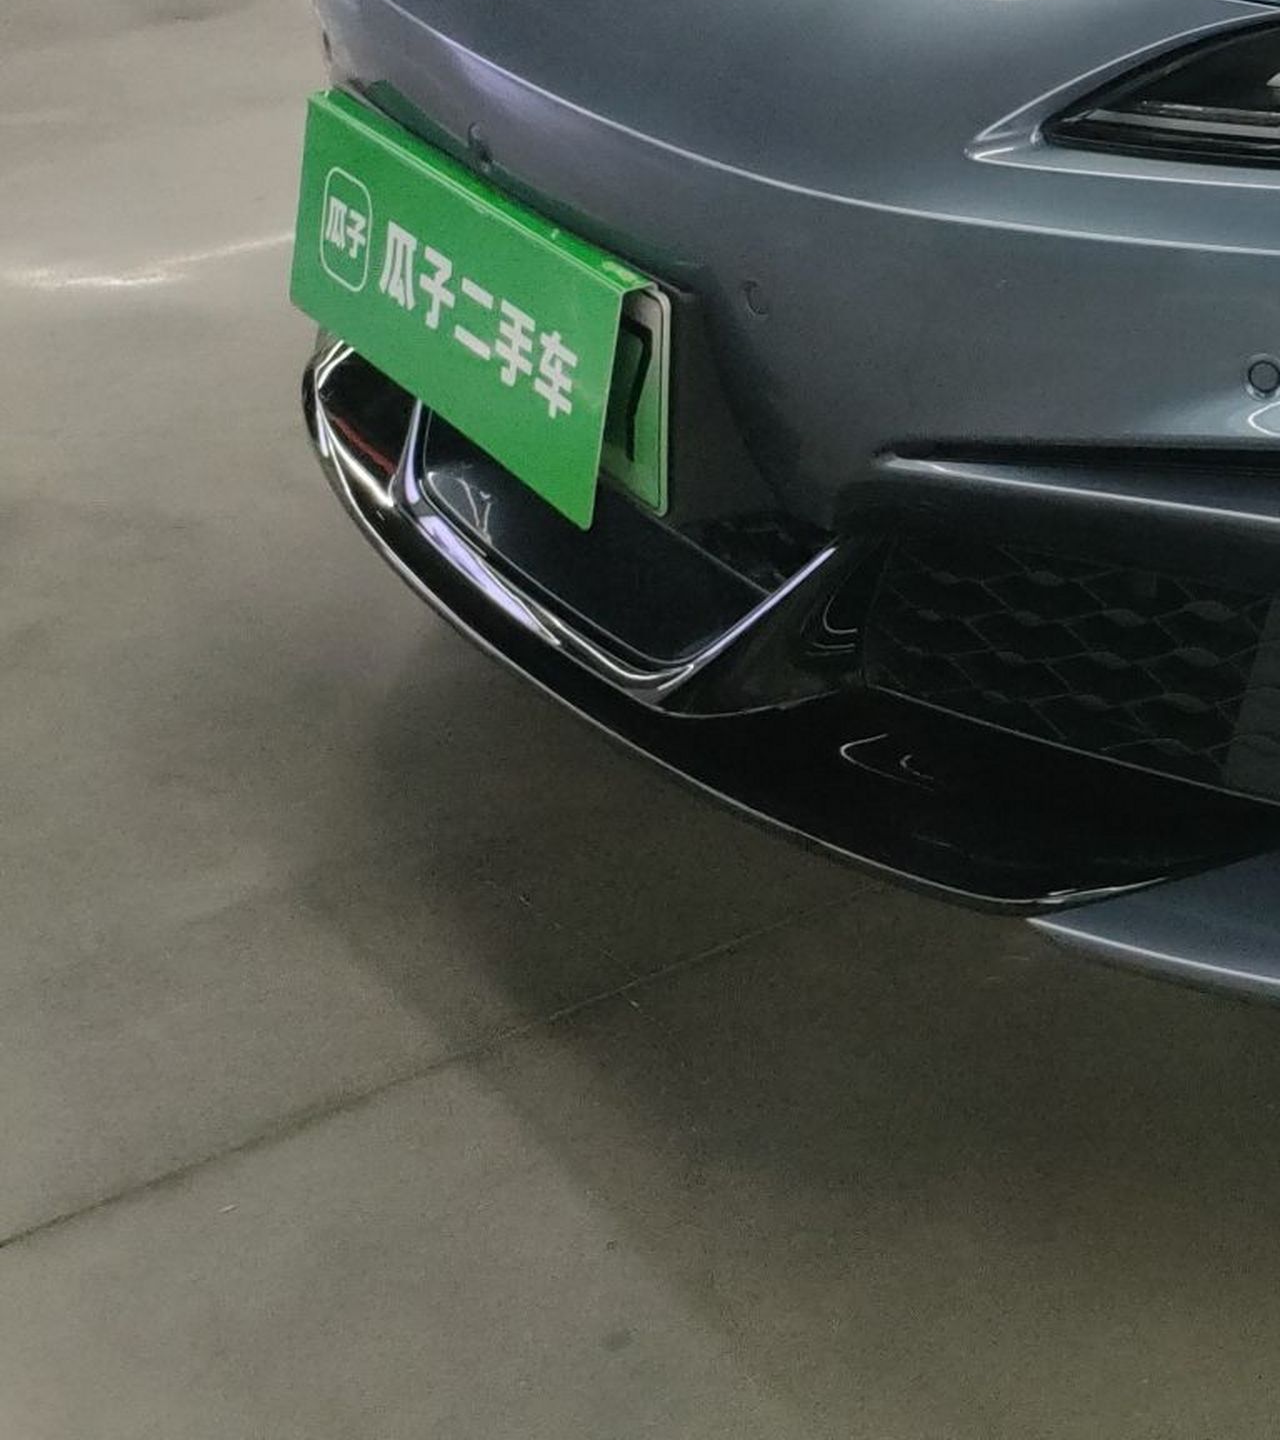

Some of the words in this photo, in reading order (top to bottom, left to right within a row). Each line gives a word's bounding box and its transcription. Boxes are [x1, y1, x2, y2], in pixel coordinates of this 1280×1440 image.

[324, 195, 368, 259] 瓜子
[379, 221, 578, 420] 瓜子二手车
